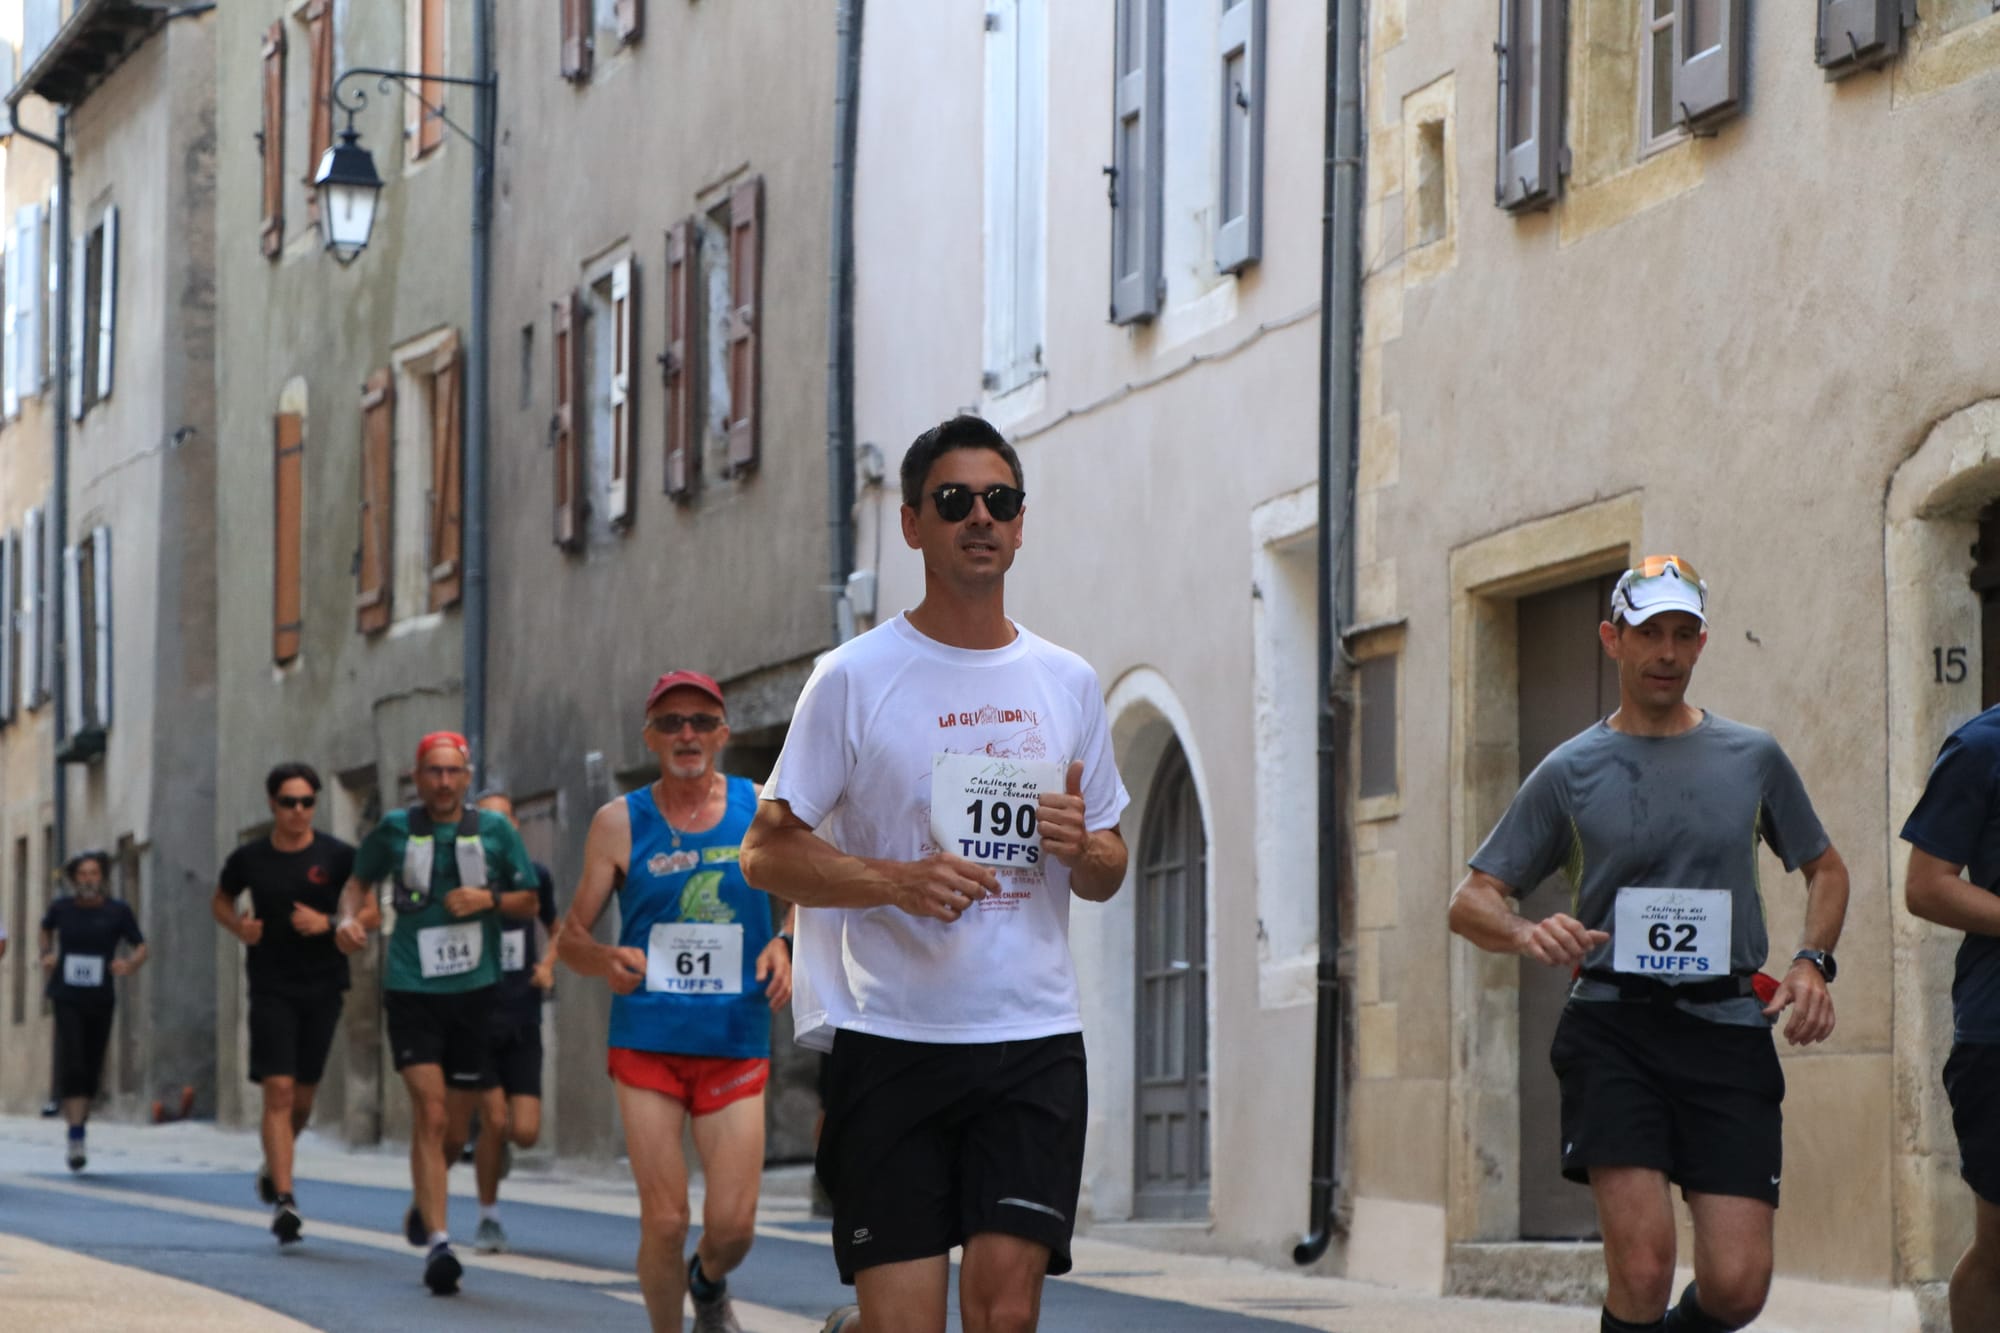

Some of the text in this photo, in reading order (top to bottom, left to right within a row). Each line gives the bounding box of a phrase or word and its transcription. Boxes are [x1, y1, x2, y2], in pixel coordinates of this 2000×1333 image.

[1933, 646, 1967, 683] 15
[939, 713, 956, 728] LA
[970, 776, 1037, 791] Challenge des
[966, 799, 1036, 839] 190
[958, 838, 1039, 864] TUFF'S
[1648, 923, 1697, 952] 62
[436, 944, 470, 962] 184
[676, 951, 711, 976] 61
[1637, 955, 1708, 971] TUFF'S
[664, 977, 724, 991] TUFF'S
